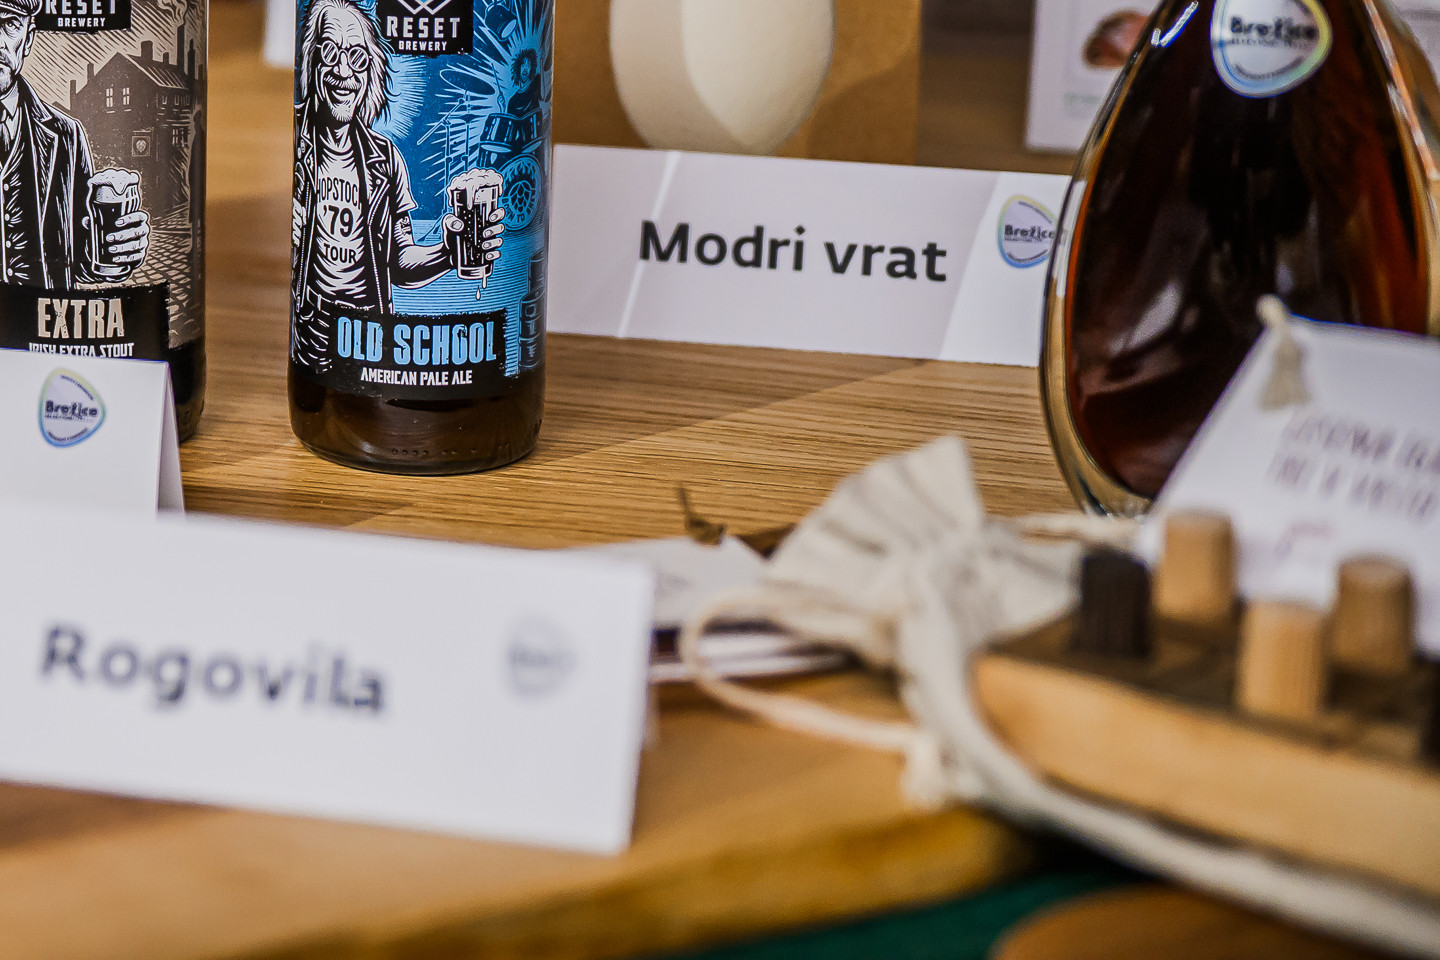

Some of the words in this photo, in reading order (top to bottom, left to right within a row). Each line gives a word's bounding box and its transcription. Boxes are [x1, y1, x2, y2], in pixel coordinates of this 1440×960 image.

[57, 17, 106, 27] BREWERY
[386, 15, 461, 38] RESET
[398, 41, 448, 51] BREWERY
[323, 243, 357, 263] TOUR
[639, 221, 805, 272] Modri
[824, 241, 948, 282] vrat
[37, 297, 125, 339] EXTRA
[59, 344, 96, 357] EXTRA
[100, 342, 135, 358] STOUT
[337, 317, 383, 362] OLD
[393, 321, 497, 366] SCHOOL
[360, 367, 417, 385] AMERICAN
[419, 370, 449, 386] PALE
[451, 369, 473, 385] ALE
[39, 621, 390, 716] Rogovila
